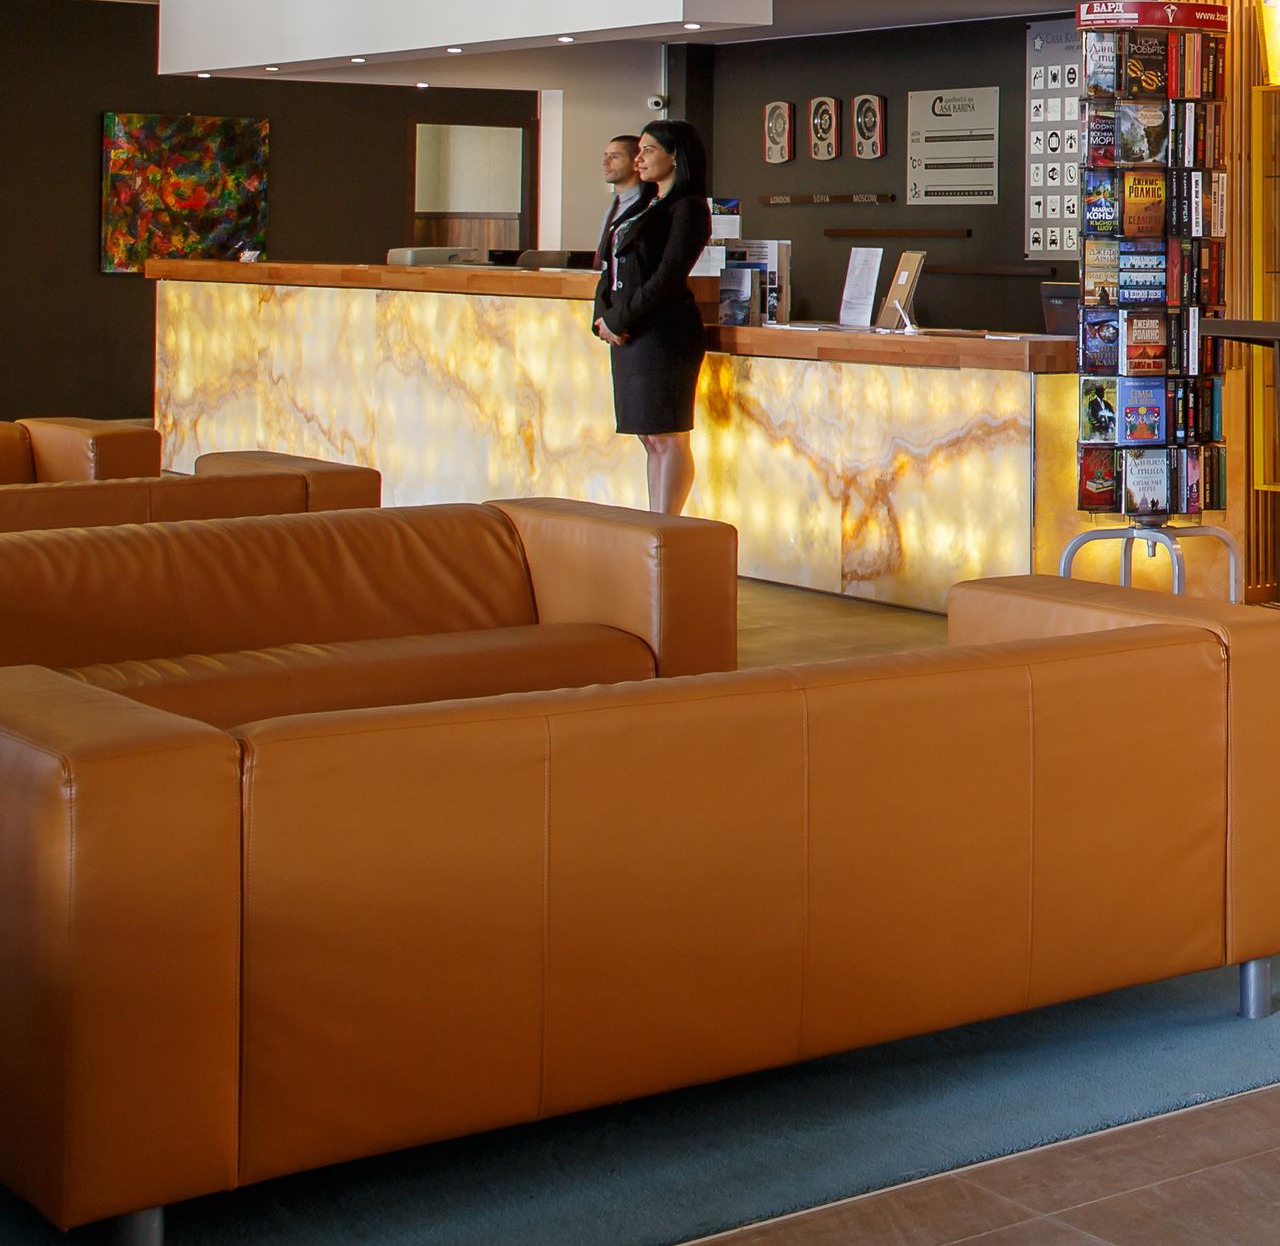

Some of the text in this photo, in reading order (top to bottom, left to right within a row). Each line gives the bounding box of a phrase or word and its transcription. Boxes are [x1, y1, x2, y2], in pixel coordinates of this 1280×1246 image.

[1093, 2, 1124, 13] БАРД
[1130, 44, 1166, 55] РОБЪРТС
[931, 95, 953, 117] CASA
[1129, 185, 1162, 199] РОЛИНС
[770, 195, 791, 204] LONDON
[813, 194, 830, 203] SOFIA
[853, 193, 877, 203] MOSCOW
[1133, 318, 1160, 329] ДЖЕЙМС
[1133, 329, 1160, 340] РОЛИНС
[1129, 458, 1165, 467] Даниел
[1130, 466, 1165, 475] Стийл
